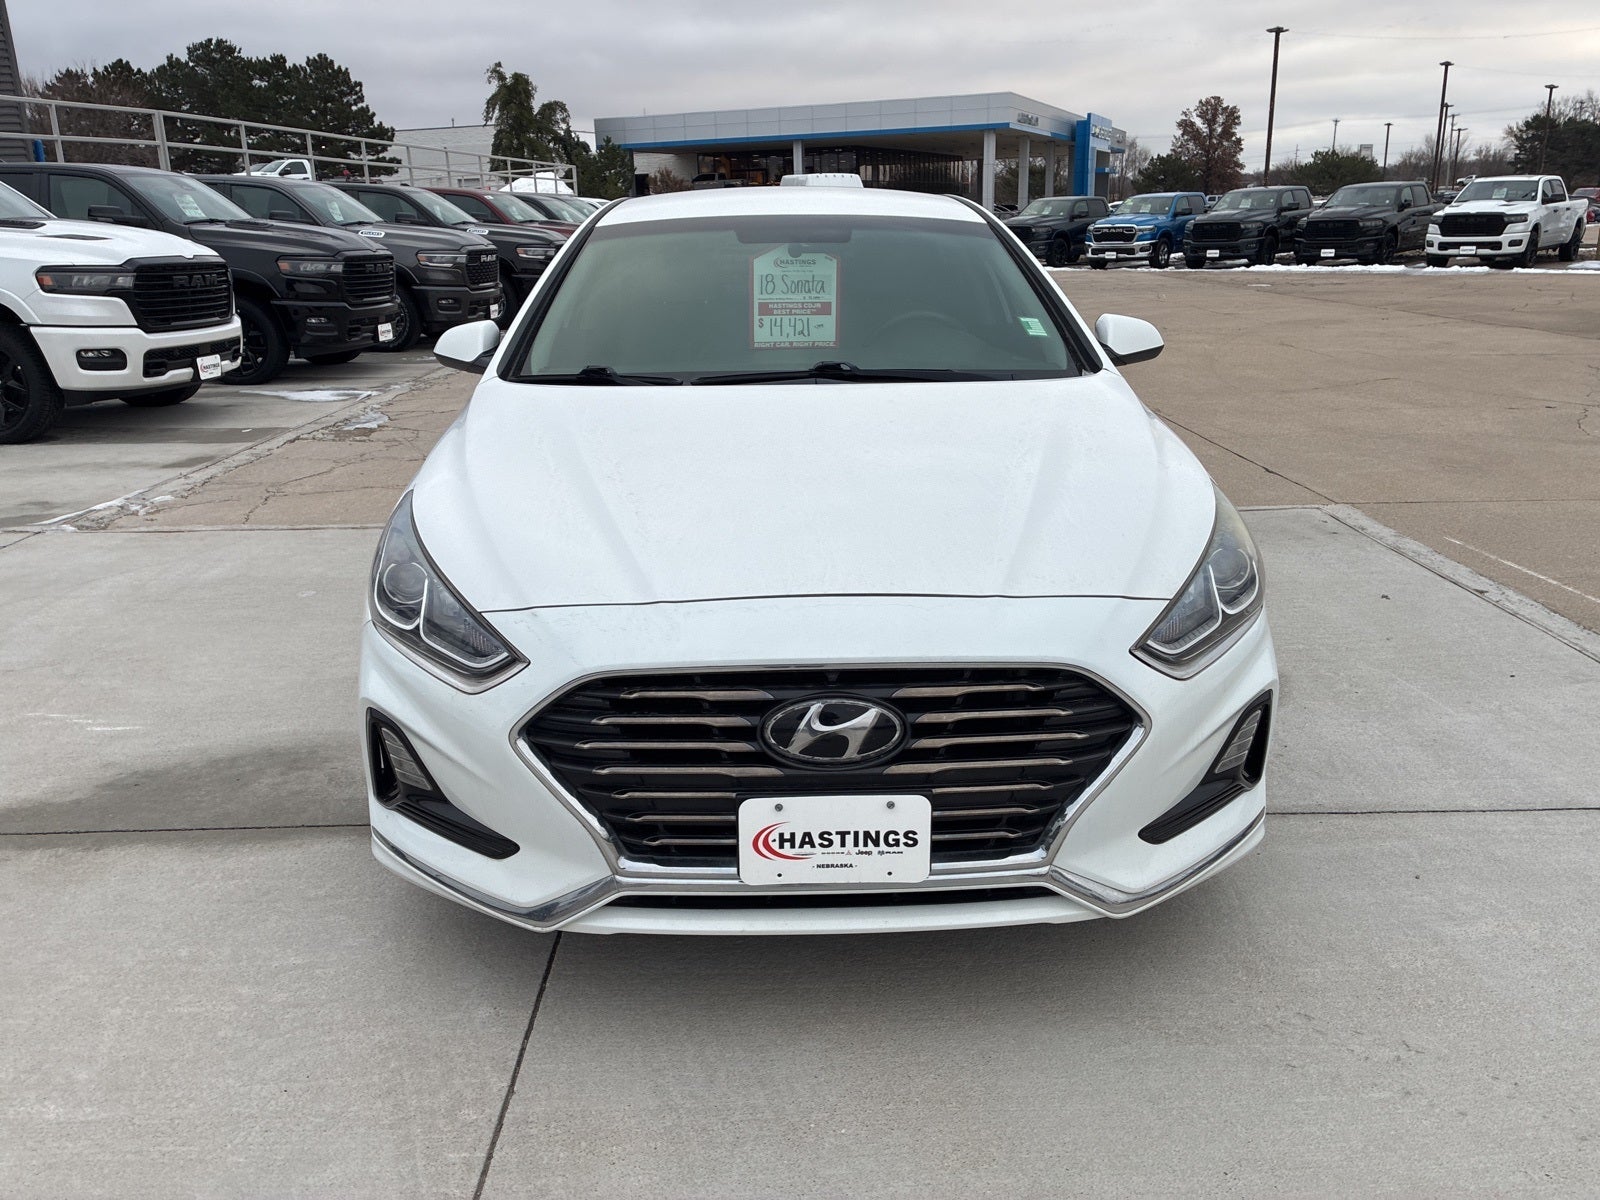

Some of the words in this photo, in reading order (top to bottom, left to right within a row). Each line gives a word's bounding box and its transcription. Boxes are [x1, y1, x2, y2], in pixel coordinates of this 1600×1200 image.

[172, 273, 218, 288] RAM
[759, 273, 776, 295] 18
[780, 273, 826, 295] Sonata
[777, 829, 919, 850] HASTINGS
[855, 849, 873, 857] Jeep
